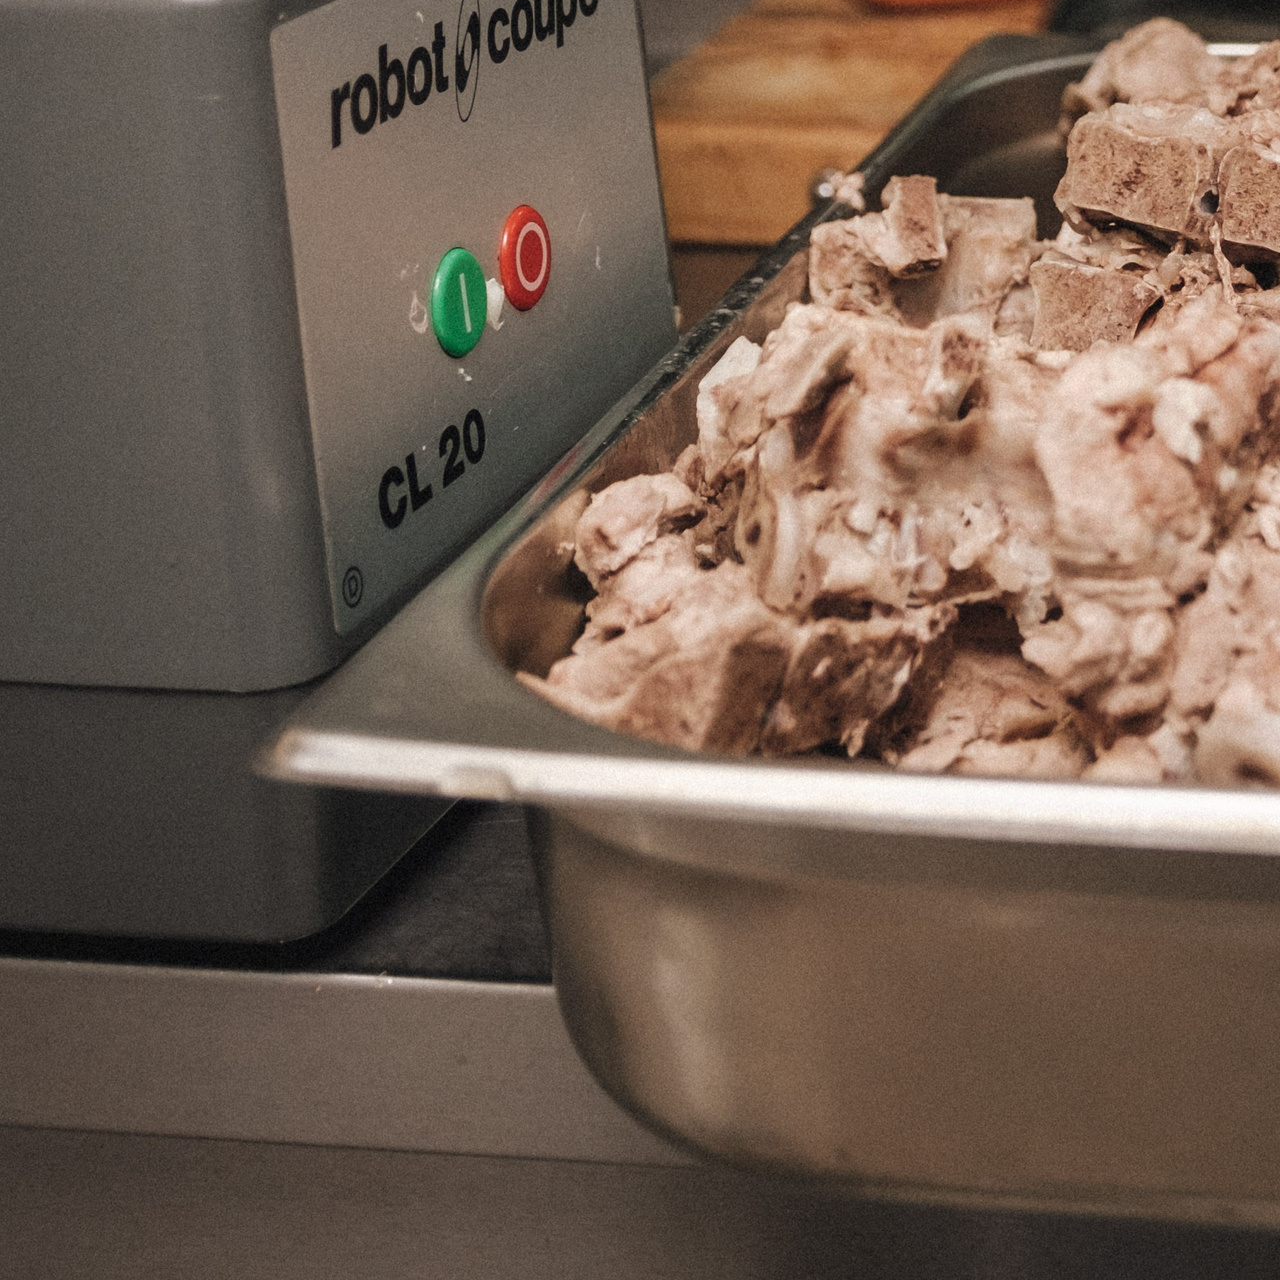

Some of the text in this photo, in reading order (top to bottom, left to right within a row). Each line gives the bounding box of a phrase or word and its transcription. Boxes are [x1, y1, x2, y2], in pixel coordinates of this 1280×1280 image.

[330, 21, 449, 150] robot
[377, 408, 486, 530] CL 20
